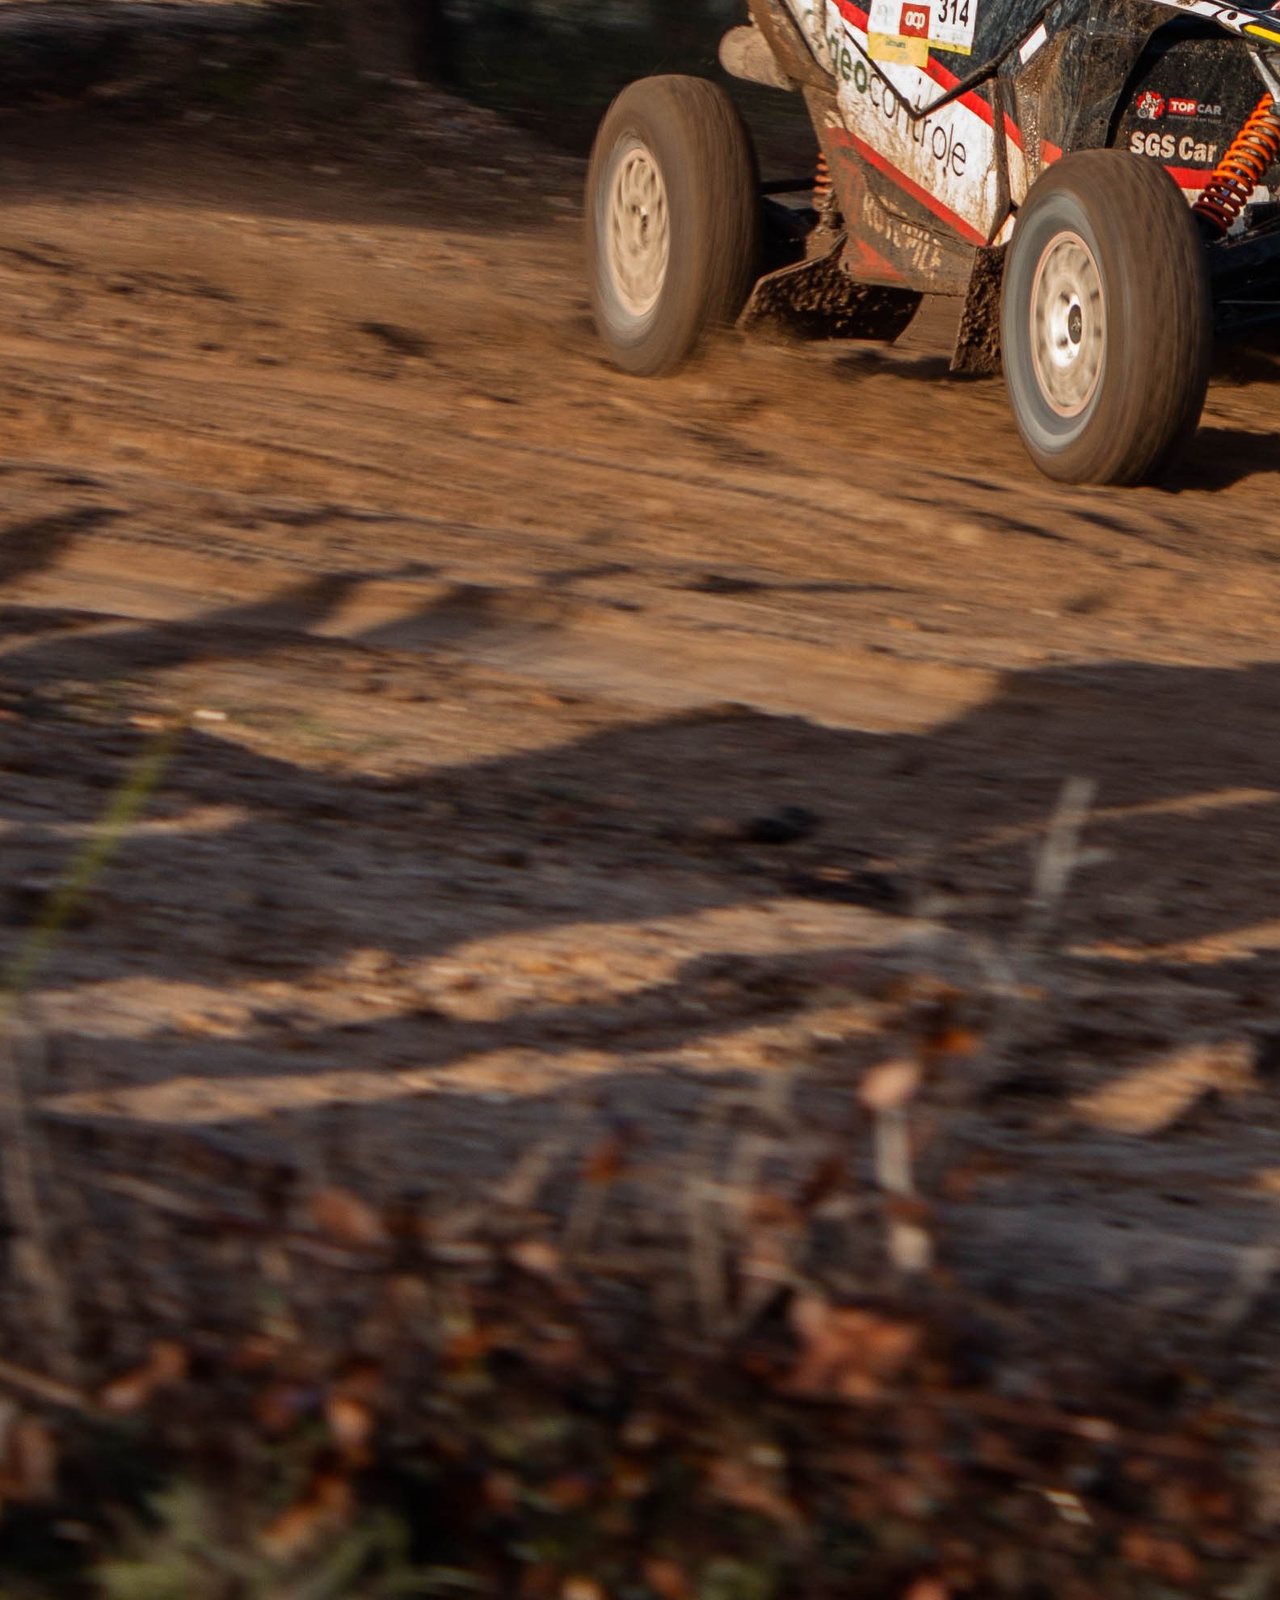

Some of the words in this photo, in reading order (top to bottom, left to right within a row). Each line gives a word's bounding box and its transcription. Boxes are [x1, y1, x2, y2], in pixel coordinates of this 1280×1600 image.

[904, 10, 926, 30] acp
[1170, 100, 1196, 113] TOP
[1196, 103, 1222, 116] CAR
[1129, 131, 1176, 159] SGS
[1178, 136, 1218, 163] Car
